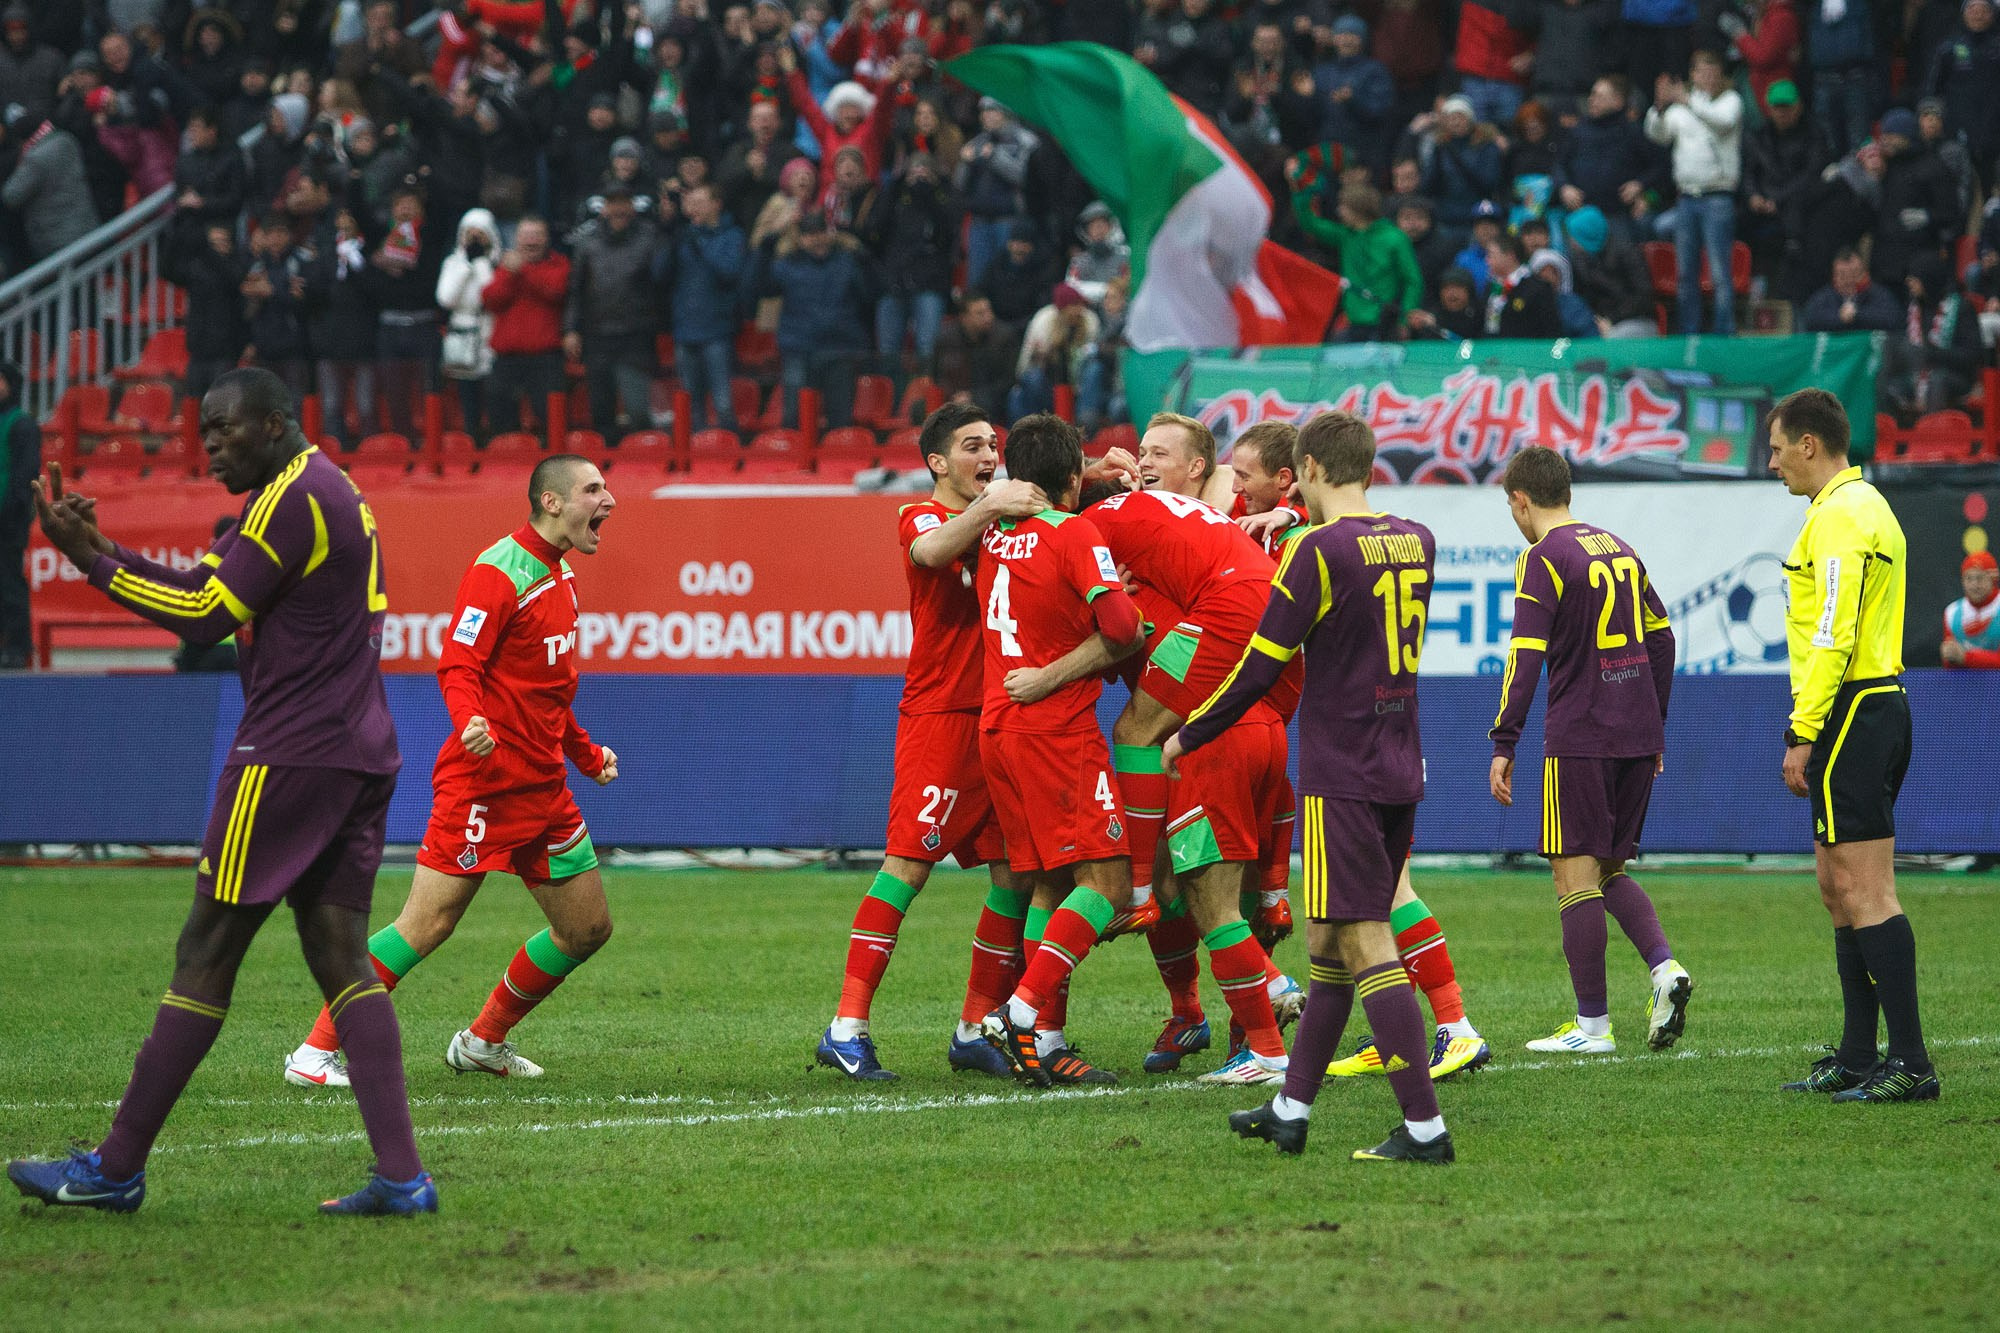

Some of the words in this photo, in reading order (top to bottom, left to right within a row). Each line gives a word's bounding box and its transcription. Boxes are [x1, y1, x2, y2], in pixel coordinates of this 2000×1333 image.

[679, 560, 754, 597] ОАО
[986, 563, 1023, 657] 4
[1373, 568, 1428, 676] 15
[1588, 556, 1644, 650] 27
[576, 611, 785, 660] РУЗОВАЯ
[1601, 666, 1640, 683] Capital
[917, 784, 959, 826] 27
[1094, 770, 1116, 811] 4
[465, 803, 489, 843] 5
